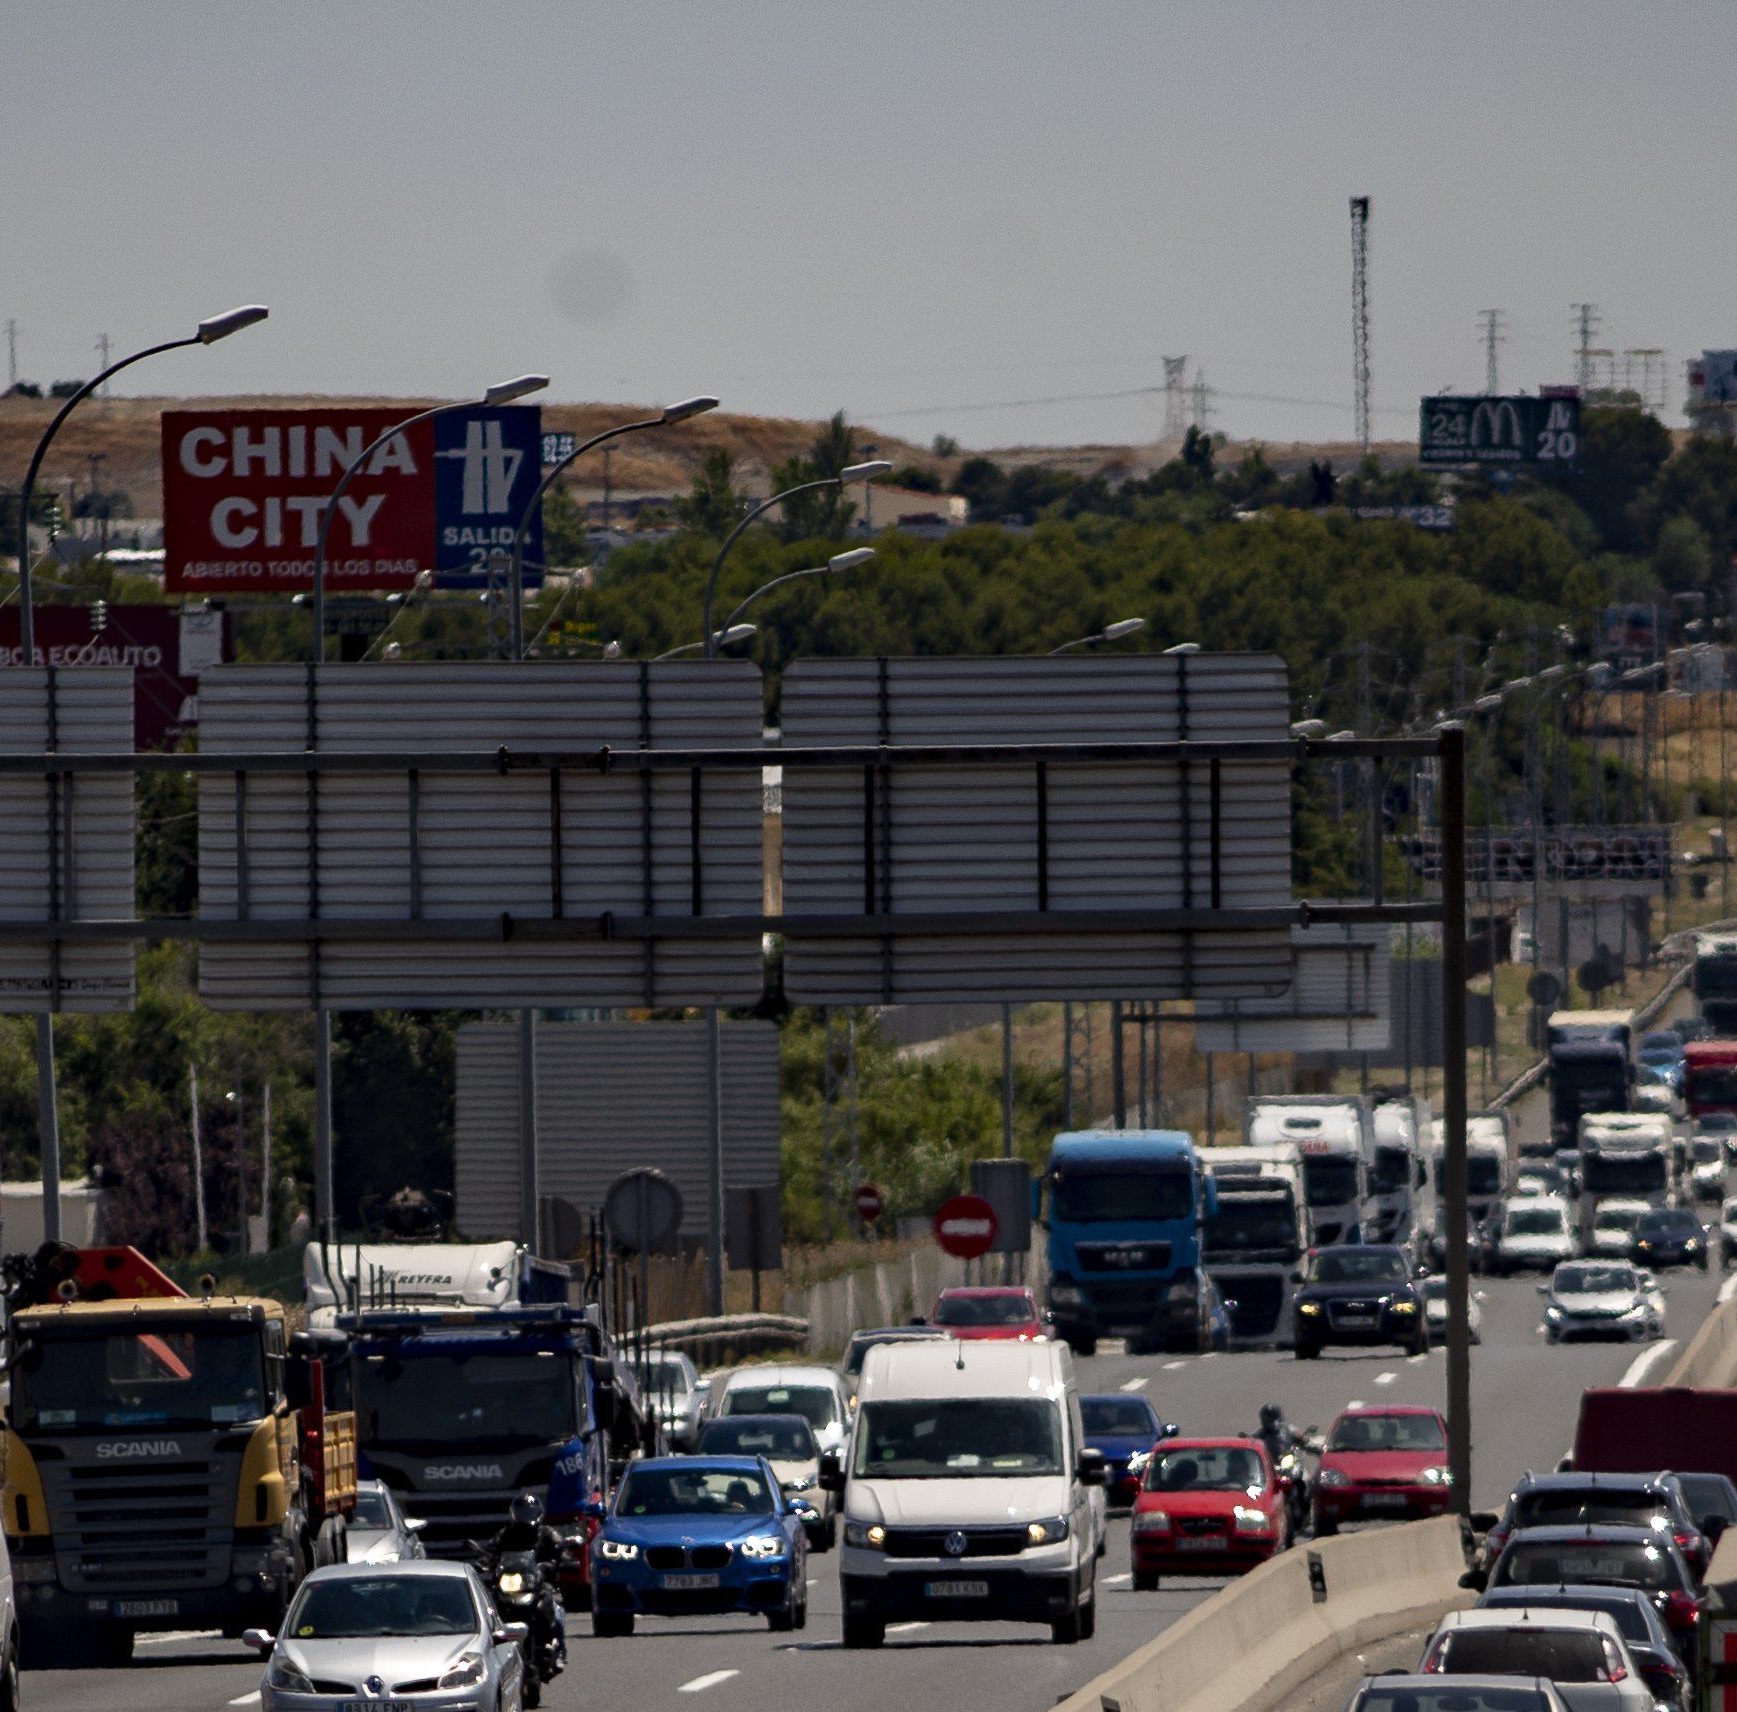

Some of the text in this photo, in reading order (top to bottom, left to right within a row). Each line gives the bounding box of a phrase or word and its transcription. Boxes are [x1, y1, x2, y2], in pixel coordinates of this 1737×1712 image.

[178, 424, 419, 478] CHINA
[1536, 430, 1577, 460] 20
[208, 493, 388, 550] CITY
[182, 560, 264, 579] ABIERTO
[333, 560, 372, 578] LOS
[397, 1273, 453, 1286] REYFRA
[95, 1440, 182, 1460] SCANIA
[422, 1463, 504, 1482] SCANIA
